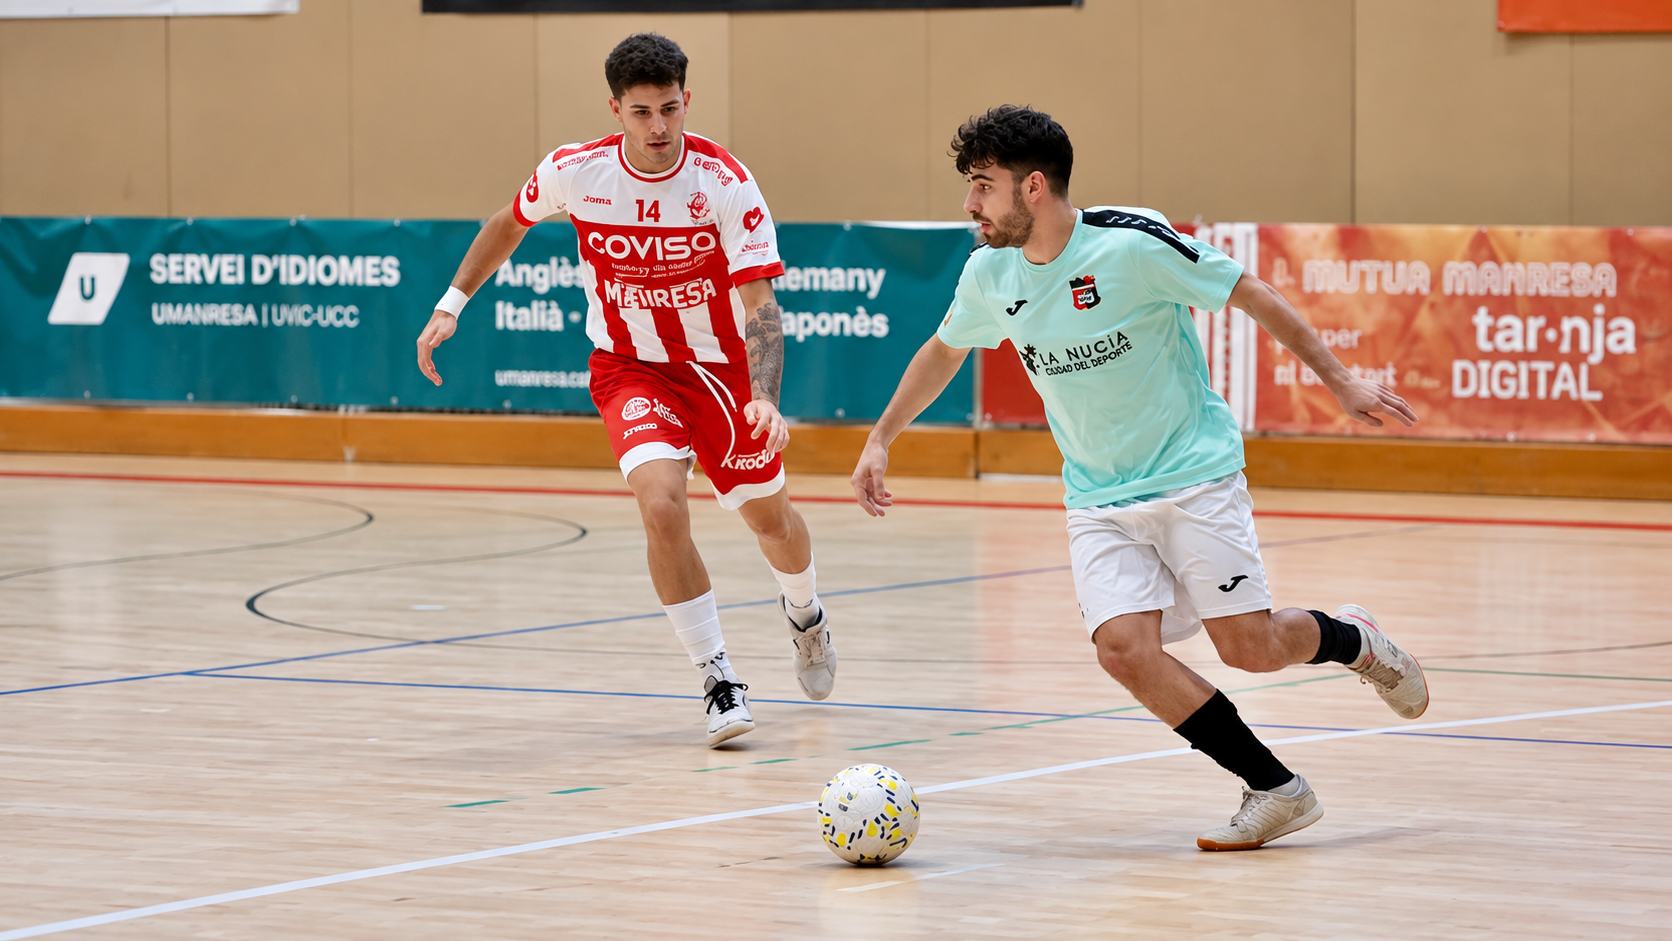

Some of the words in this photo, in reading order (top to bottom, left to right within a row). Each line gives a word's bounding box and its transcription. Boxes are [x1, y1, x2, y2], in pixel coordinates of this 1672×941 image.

[583, 195, 612, 206] Joma
[635, 199, 661, 223] 14
[588, 231, 717, 261] COVISO
[150, 253, 246, 285] SERVEI
[251, 254, 401, 287] D'IDIOMES
[772, 260, 887, 300] lemany
[1302, 259, 1431, 295] MUTUA
[1442, 261, 1618, 298] MANRESA
[151, 303, 259, 326] UMANRESA
[271, 303, 360, 328] UVIC-UCC
[495, 300, 565, 332] Italià
[777, 305, 890, 343] aponès
[1039, 352, 1059, 366] LA
[1074, 360, 1091, 371] DEL
[1090, 340, 1133, 368] DEPORTE
[1452, 359, 1603, 401] DIGITAL
